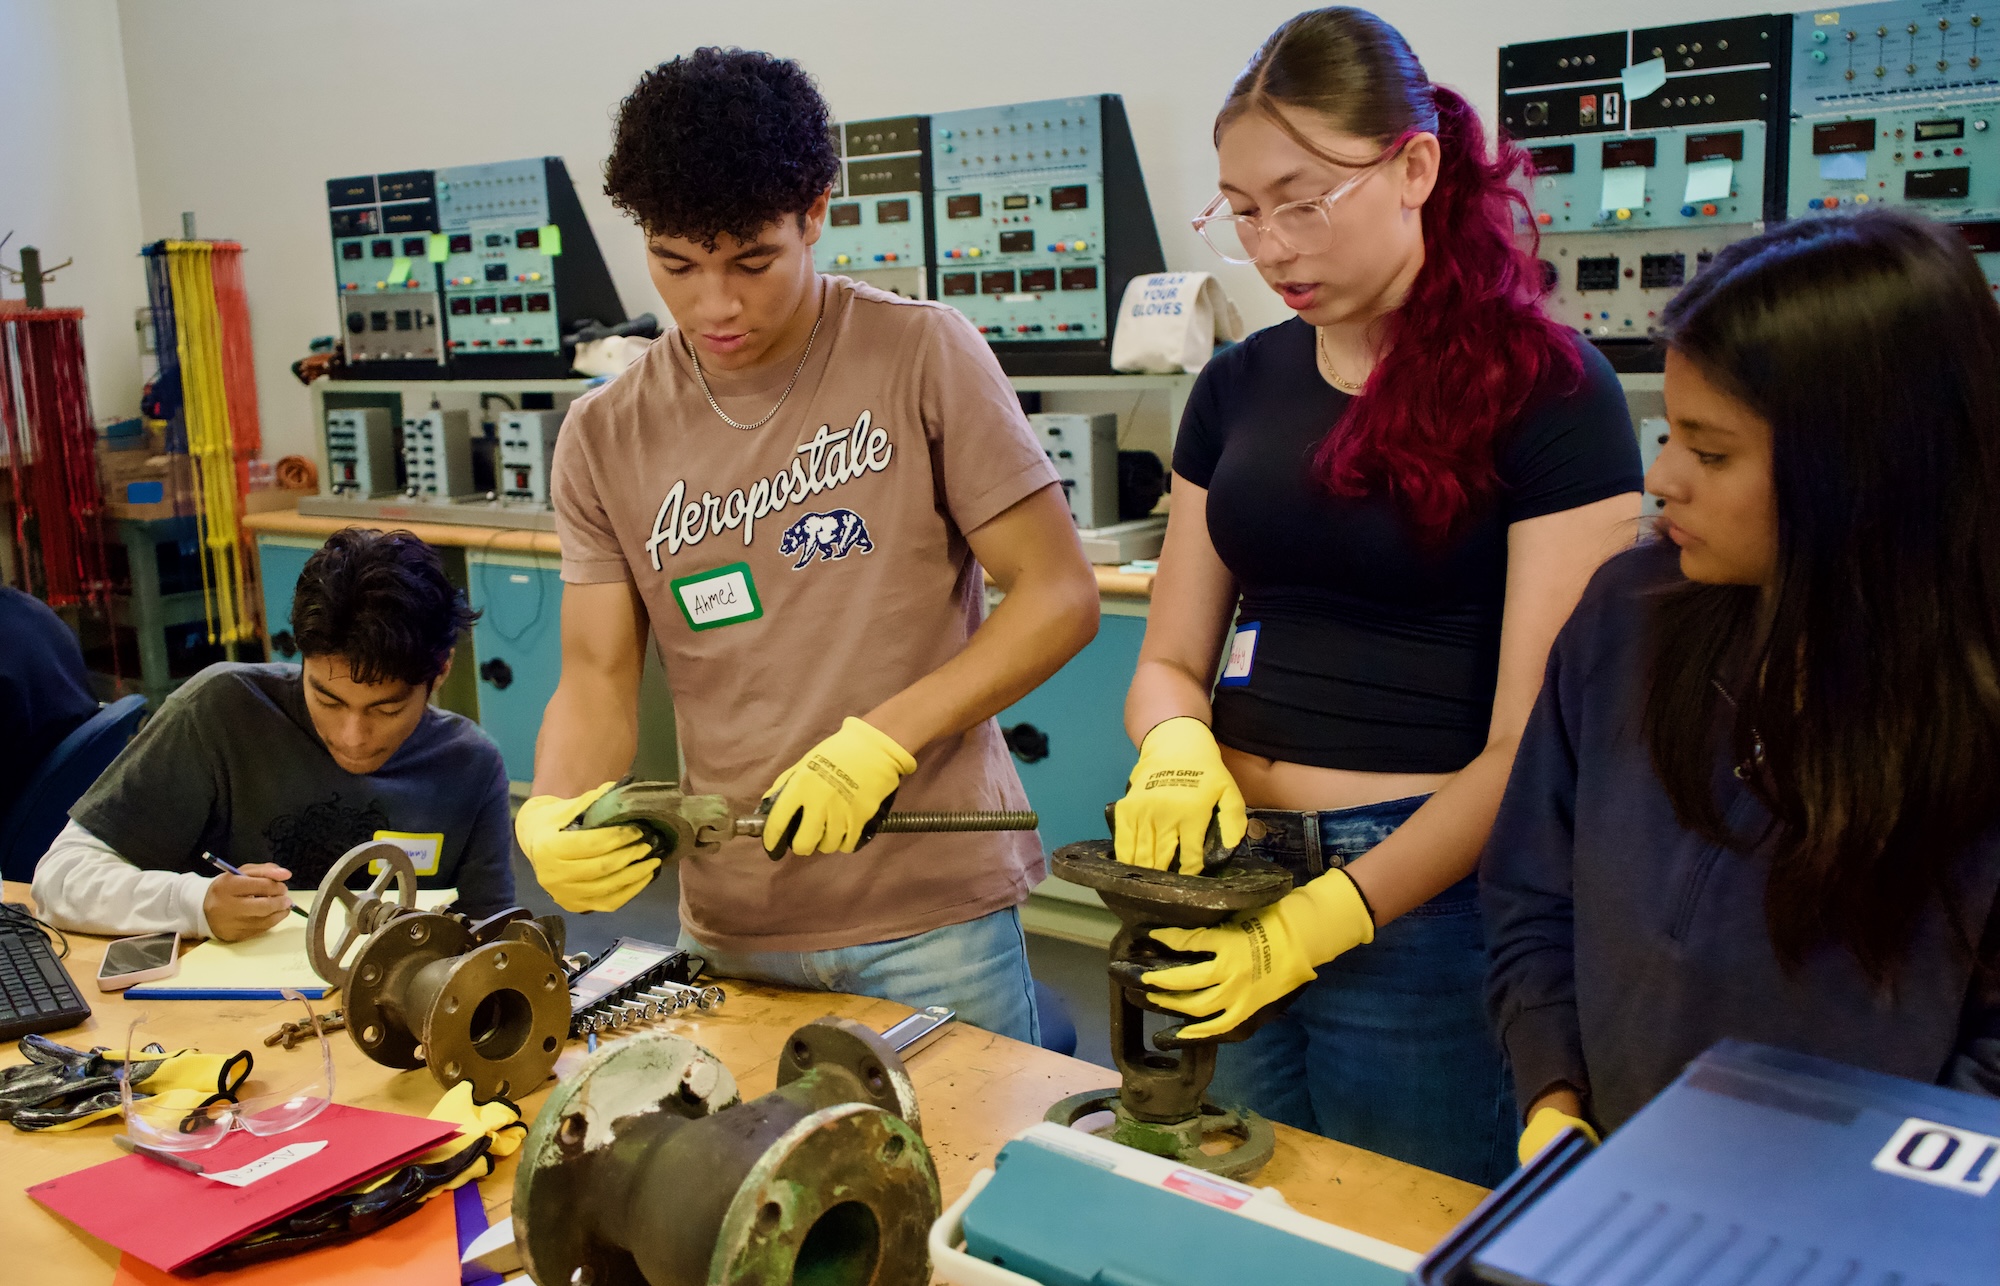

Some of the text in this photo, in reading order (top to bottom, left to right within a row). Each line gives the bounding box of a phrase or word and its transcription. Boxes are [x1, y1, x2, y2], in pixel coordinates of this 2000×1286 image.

[1605, 95, 1617, 121] 4
[1144, 288, 1178, 300] YOUR
[1132, 302, 1182, 317] GLOVES
[645, 408, 893, 571] Aeropostale
[694, 582, 737, 616] Ahmed
[814, 754, 836, 772] FIRM
[836, 769, 859, 791] GRIP
[1149, 769, 1204, 780] FIRM GRIP
[1250, 917, 1268, 944] FIRM
[1263, 944, 1271, 974] GRIP
